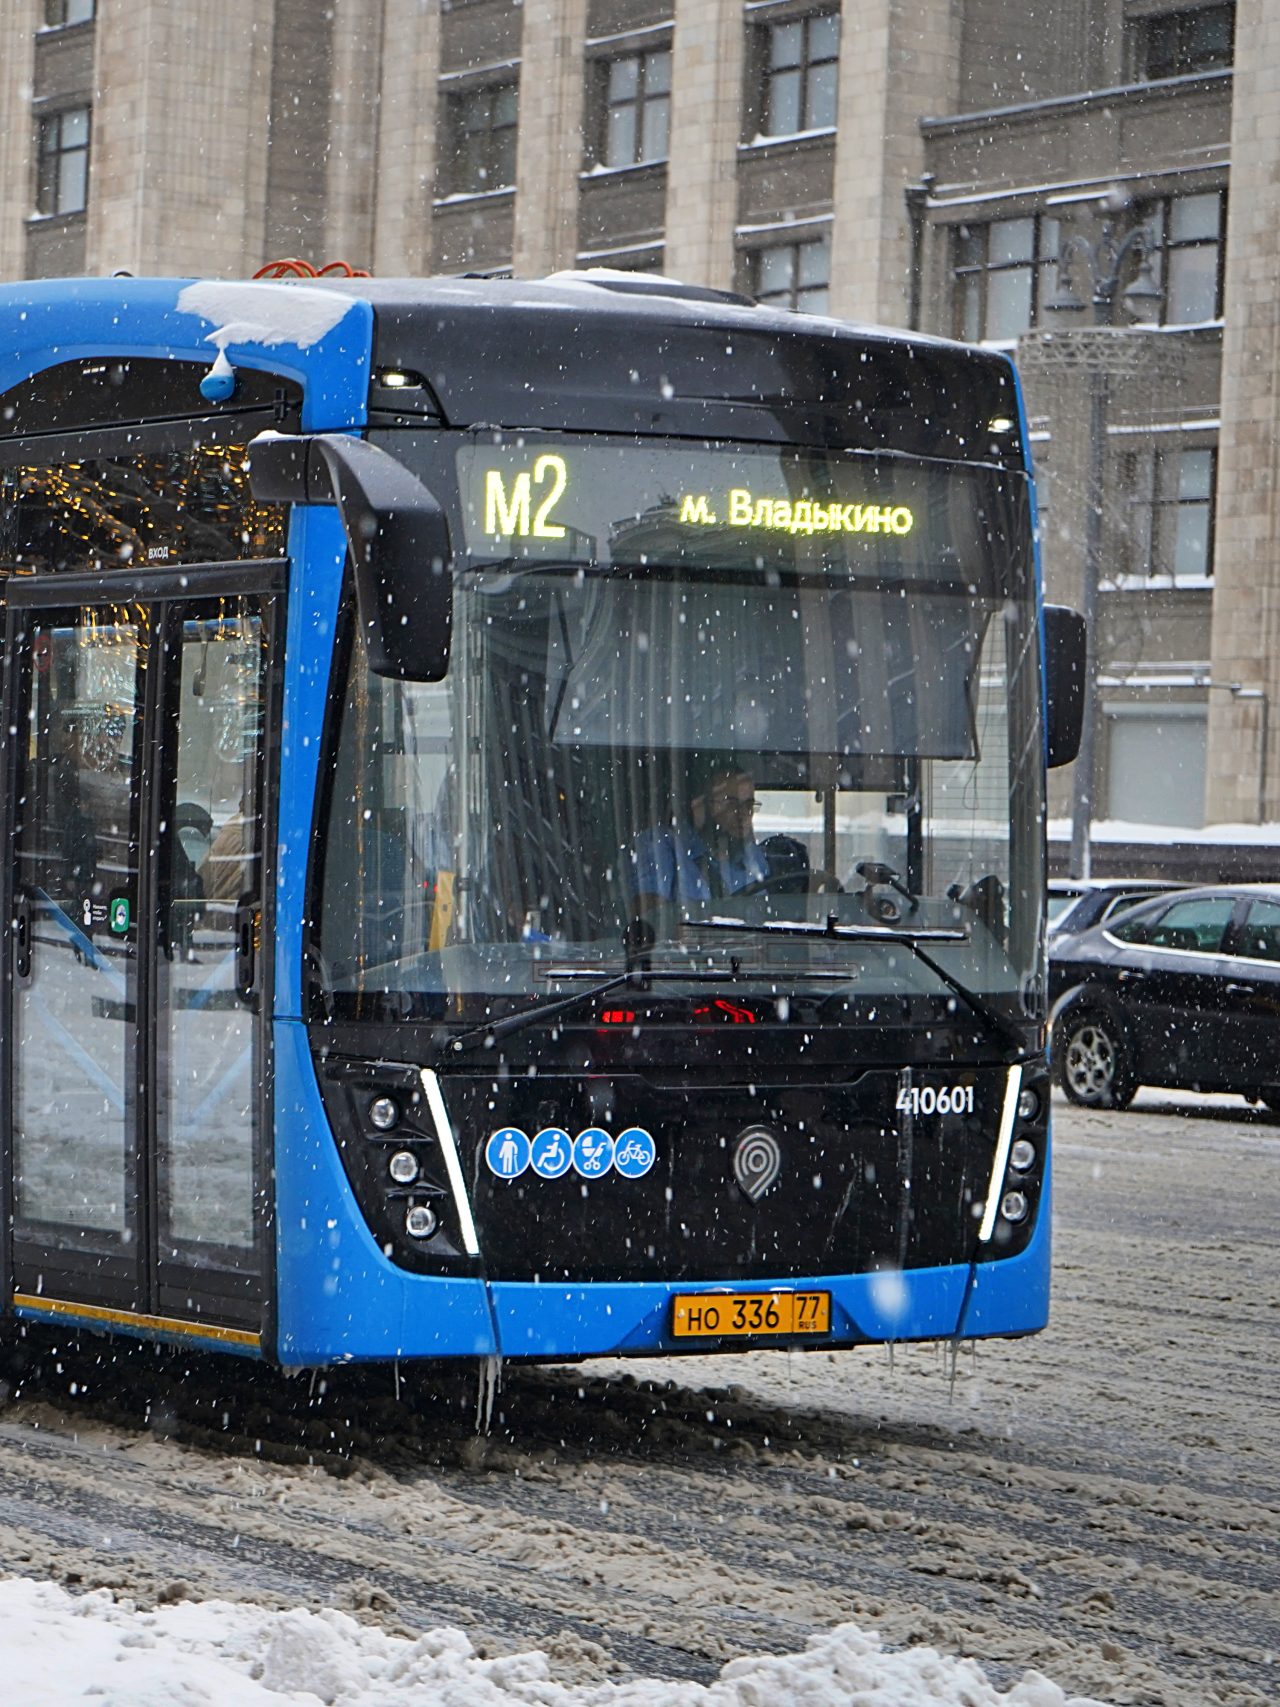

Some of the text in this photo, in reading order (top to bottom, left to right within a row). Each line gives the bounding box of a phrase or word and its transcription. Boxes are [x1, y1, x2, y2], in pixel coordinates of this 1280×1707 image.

[485, 455, 567, 538] М2
[730, 489, 914, 536] Владыкино
[895, 1086, 974, 1115] 410601
[732, 1299, 780, 1329] 336
[796, 1296, 821, 1320] 77
[798, 1320, 817, 1330] RUS
